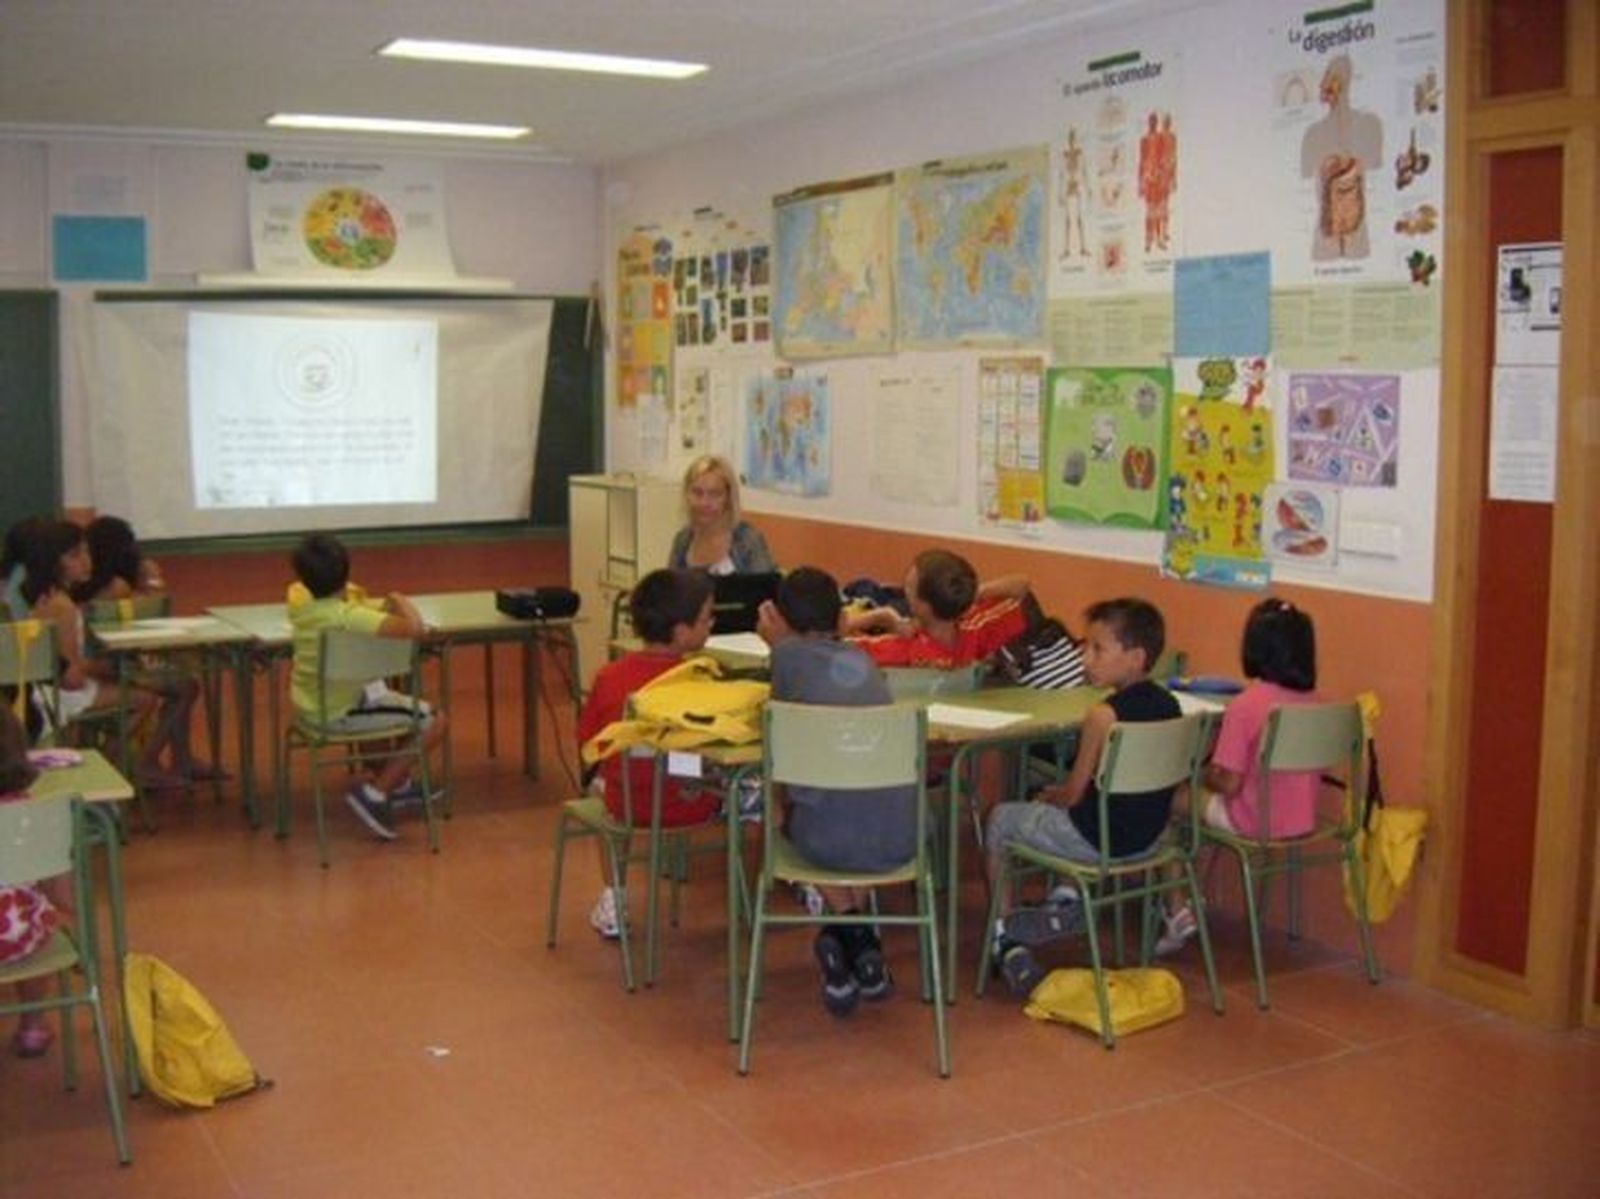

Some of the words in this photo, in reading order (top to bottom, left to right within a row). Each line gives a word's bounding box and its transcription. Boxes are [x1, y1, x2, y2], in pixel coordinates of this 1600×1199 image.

[1288, 28, 1301, 44] La
[1303, 18, 1375, 54] digestión
[1103, 60, 1163, 89] locomotor
